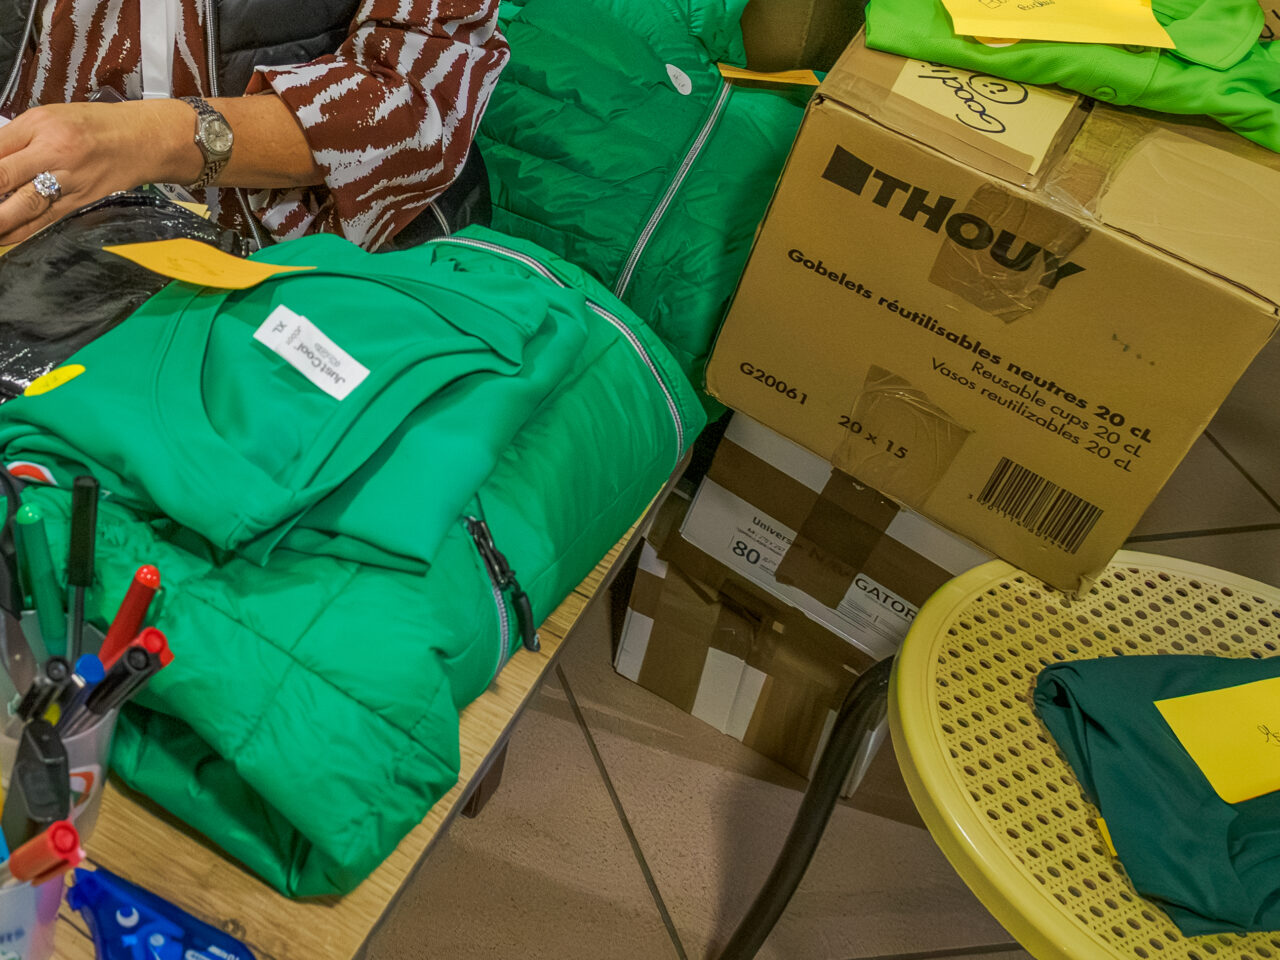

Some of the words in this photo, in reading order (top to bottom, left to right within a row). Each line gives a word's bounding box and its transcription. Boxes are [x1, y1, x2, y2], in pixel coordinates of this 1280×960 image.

[872, 168, 1087, 290] THOUY
[788, 249, 873, 299] Gobelets
[877, 297, 1002, 365] réutilisables
[1006, 362, 1088, 409] neutres
[1093, 405, 1125, 427] 20
[739, 362, 808, 405] G20061
[932, 356, 977, 390] Vasos
[980, 387, 1080, 445] reutilizables
[1084, 440, 1111, 459] 20
[971, 361, 1046, 407] Reusable
[1049, 405, 1089, 430] cups
[1094, 425, 1120, 445] 20
[837, 415, 862, 434] 20
[885, 439, 908, 459] 15
[733, 541, 760, 565] 80
[753, 516, 793, 544] Univers
